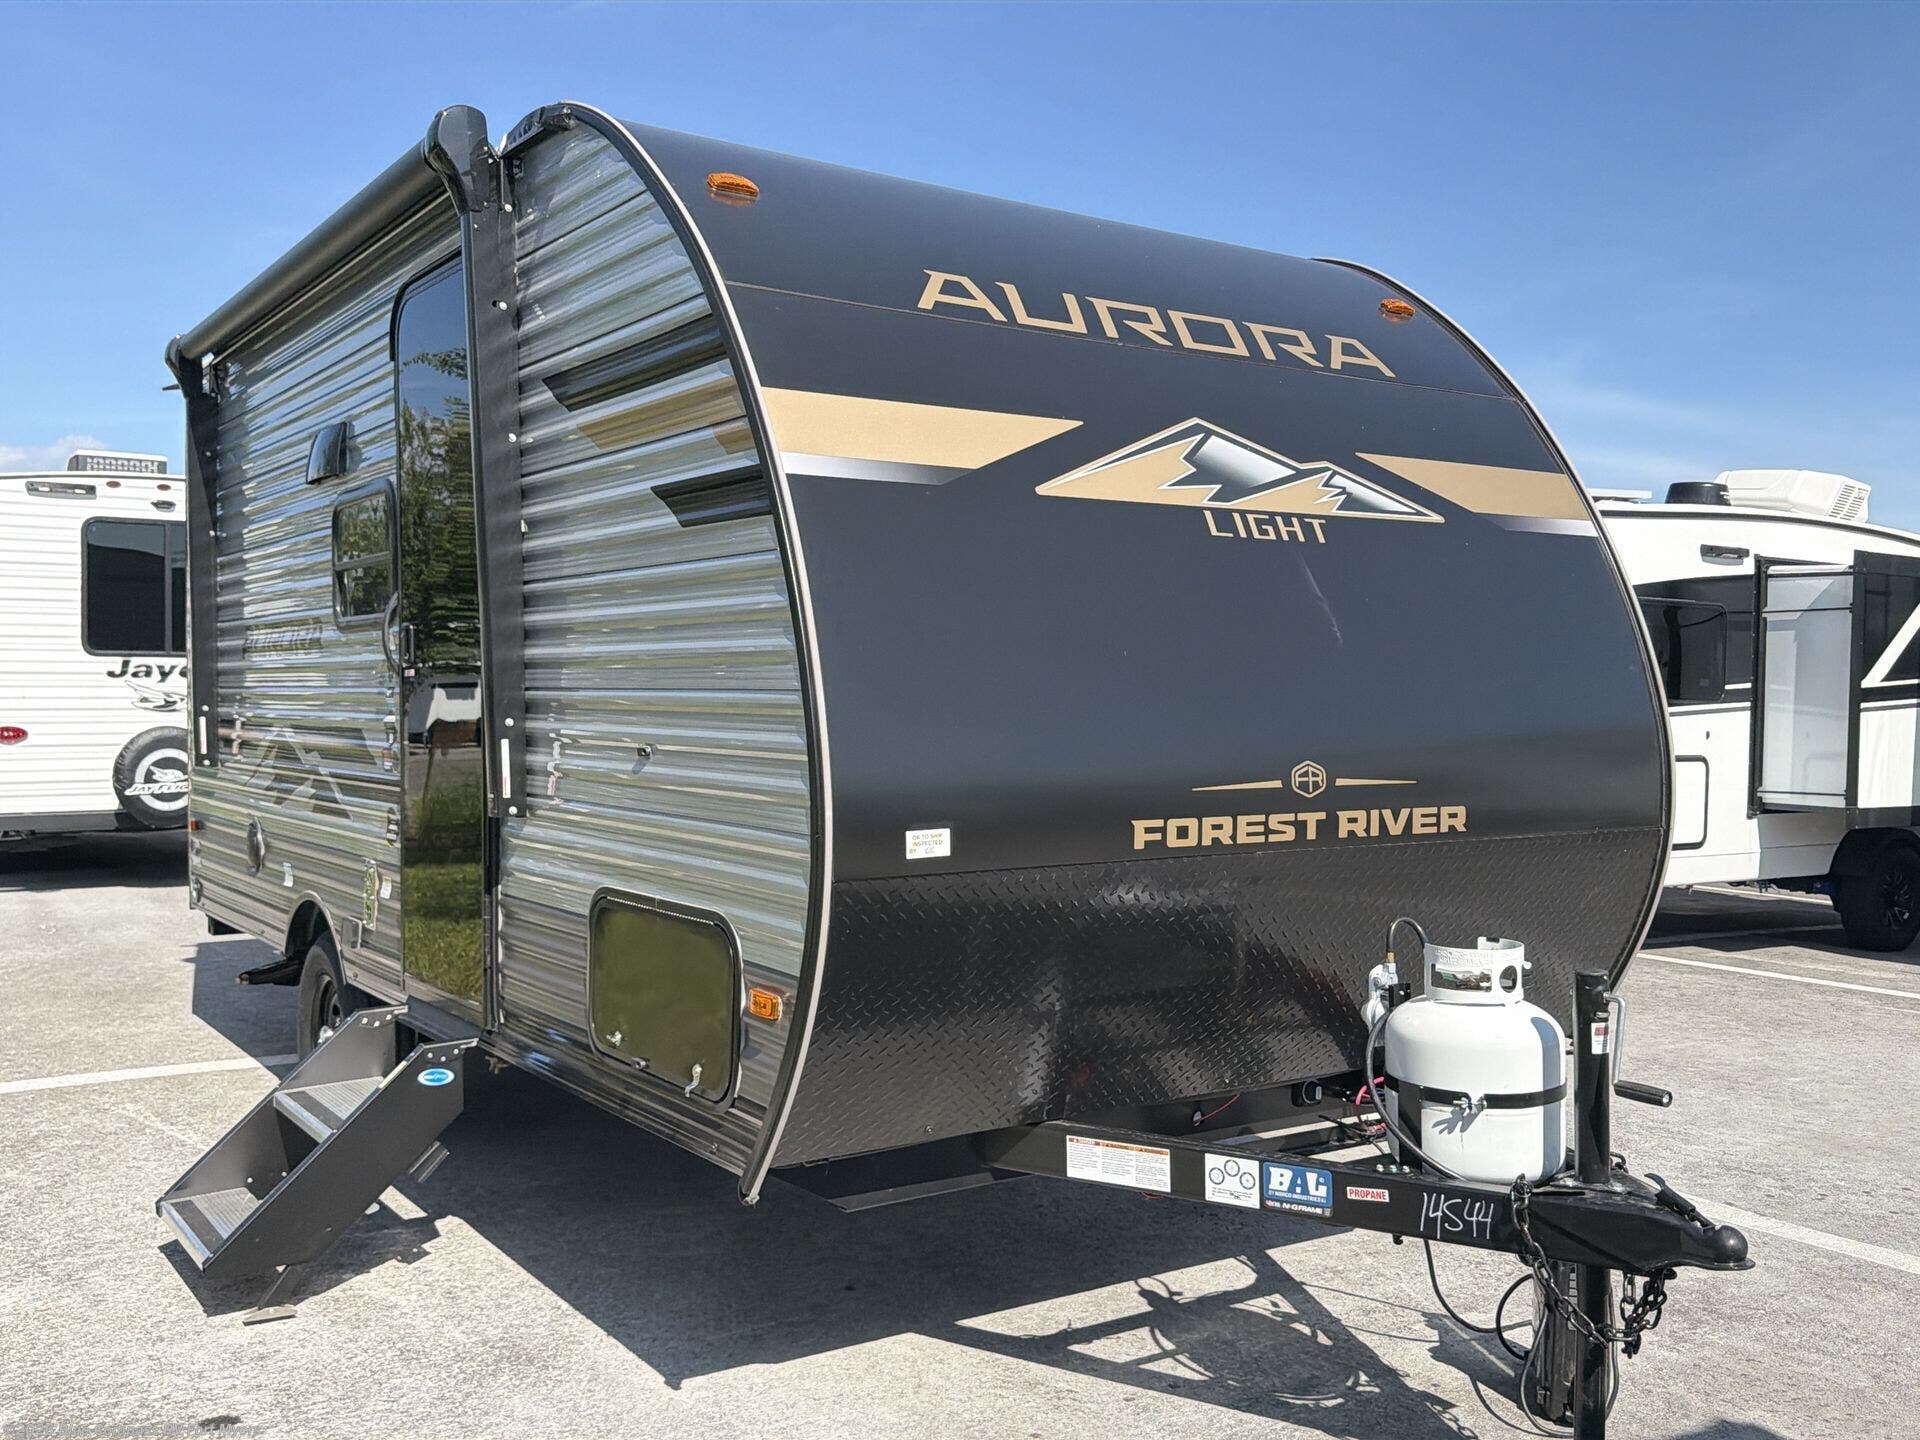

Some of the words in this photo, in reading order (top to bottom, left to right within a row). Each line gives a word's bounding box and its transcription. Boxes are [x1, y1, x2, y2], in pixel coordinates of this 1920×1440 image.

[917, 269, 1396, 377] AURORA
[1203, 510, 1326, 543] LIGHT
[1130, 811, 1327, 850] FOREST
[1336, 805, 1467, 839] RIVER
[1268, 1166, 1327, 1197] BAL
[1349, 1188, 1387, 1201] PROPANE
[1420, 1192, 1494, 1240] 14544
